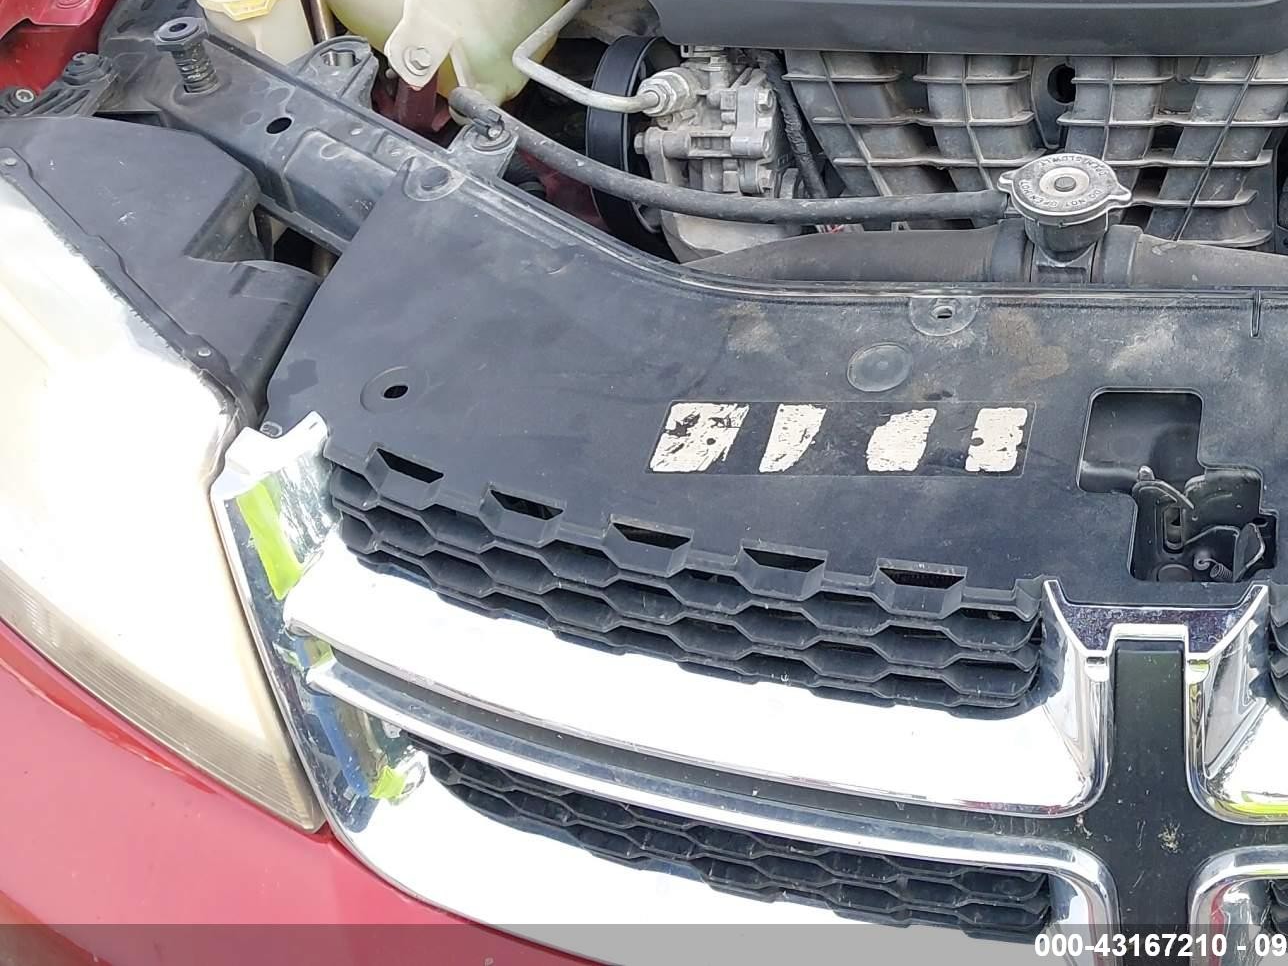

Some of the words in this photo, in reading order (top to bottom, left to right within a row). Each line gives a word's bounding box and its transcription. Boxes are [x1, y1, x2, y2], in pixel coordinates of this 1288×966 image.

[1088, 189, 1102, 199] DO
[1031, 195, 1058, 207] OPEN
[1065, 198, 1087, 207] NOT
